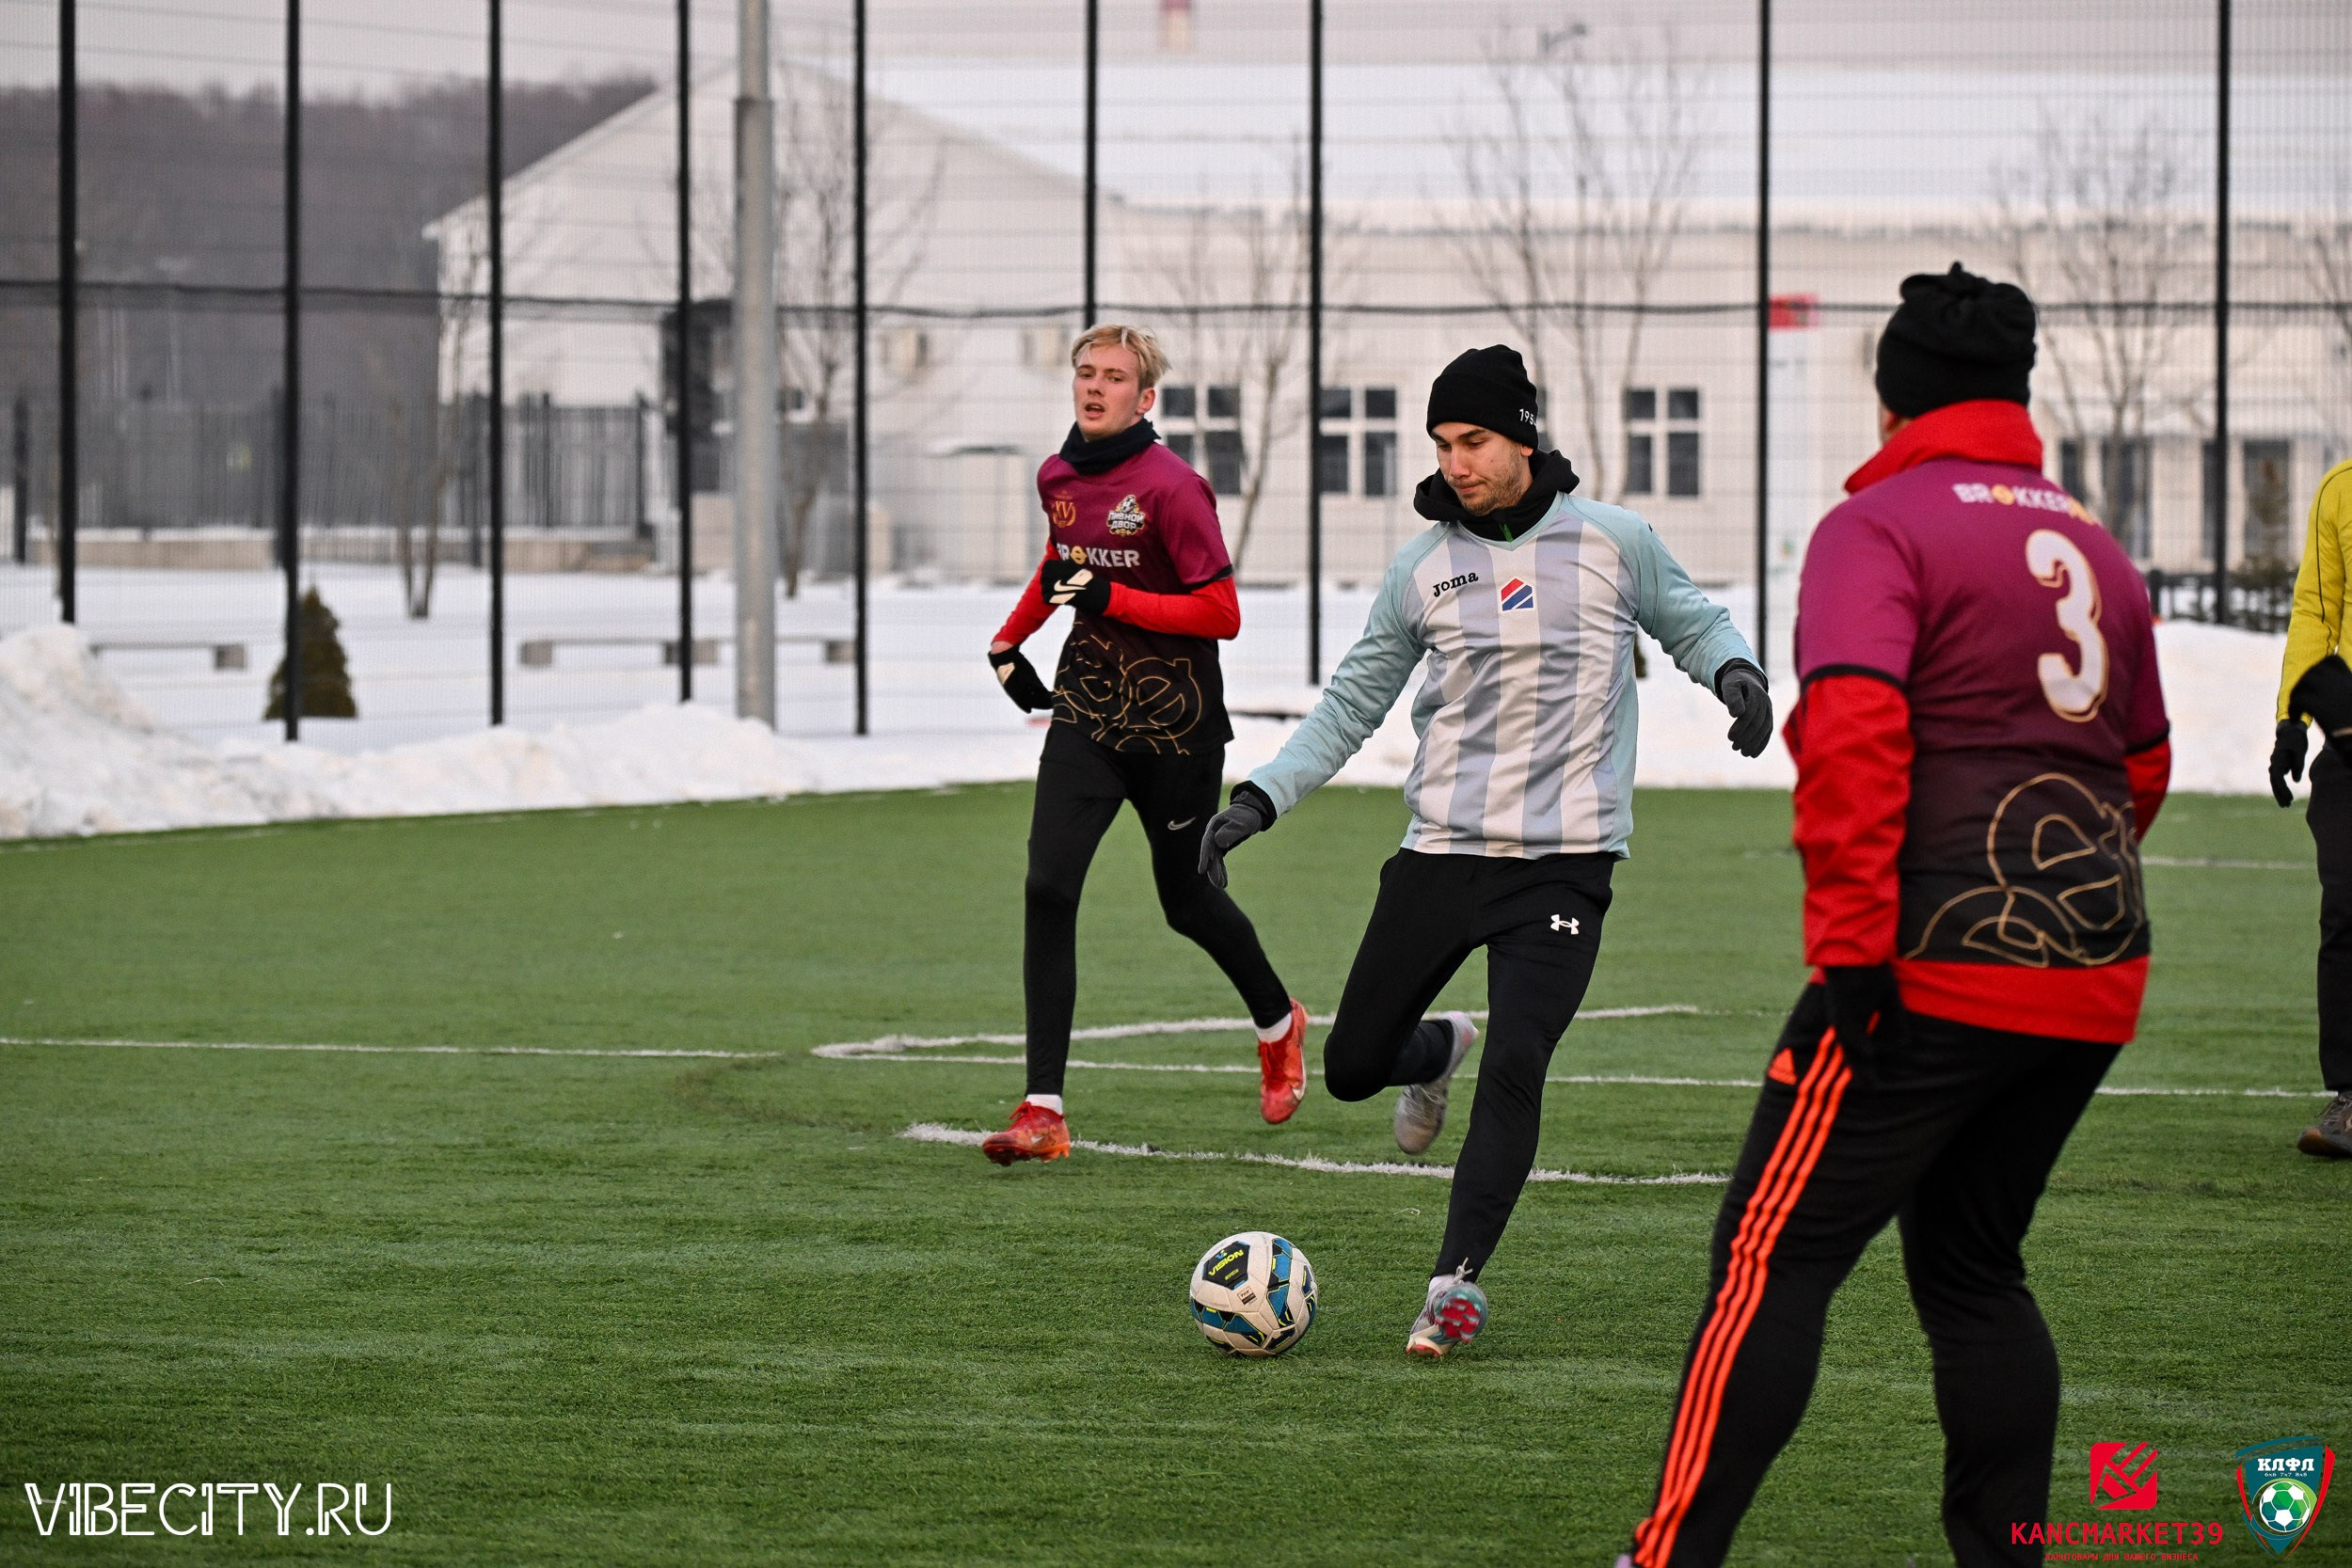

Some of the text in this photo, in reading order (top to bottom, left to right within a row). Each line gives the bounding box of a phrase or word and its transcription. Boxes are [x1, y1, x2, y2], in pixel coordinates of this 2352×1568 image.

[1110, 520, 1136, 531] ДВОР
[2026, 529, 2109, 722] 3
[1208, 1249, 1244, 1276] VISION
